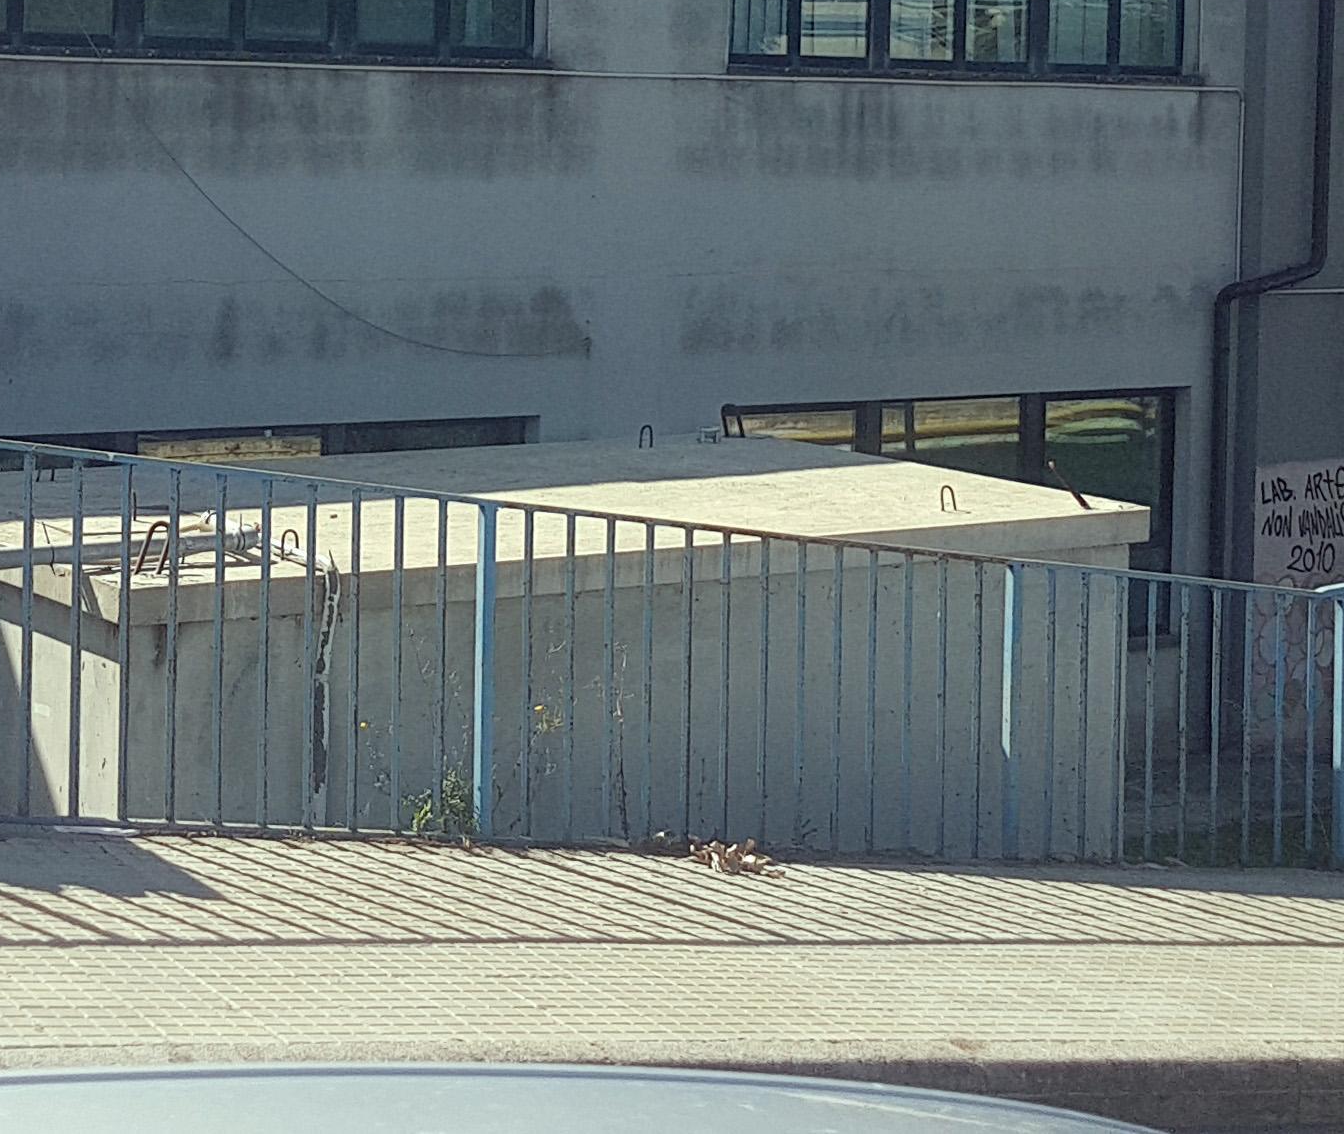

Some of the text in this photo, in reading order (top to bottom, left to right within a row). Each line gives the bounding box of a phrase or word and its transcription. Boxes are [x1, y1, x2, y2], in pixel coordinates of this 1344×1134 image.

[1260, 476, 1297, 505] LAB.
[1261, 505, 1293, 539] NON
[1286, 540, 1336, 574] 2010
